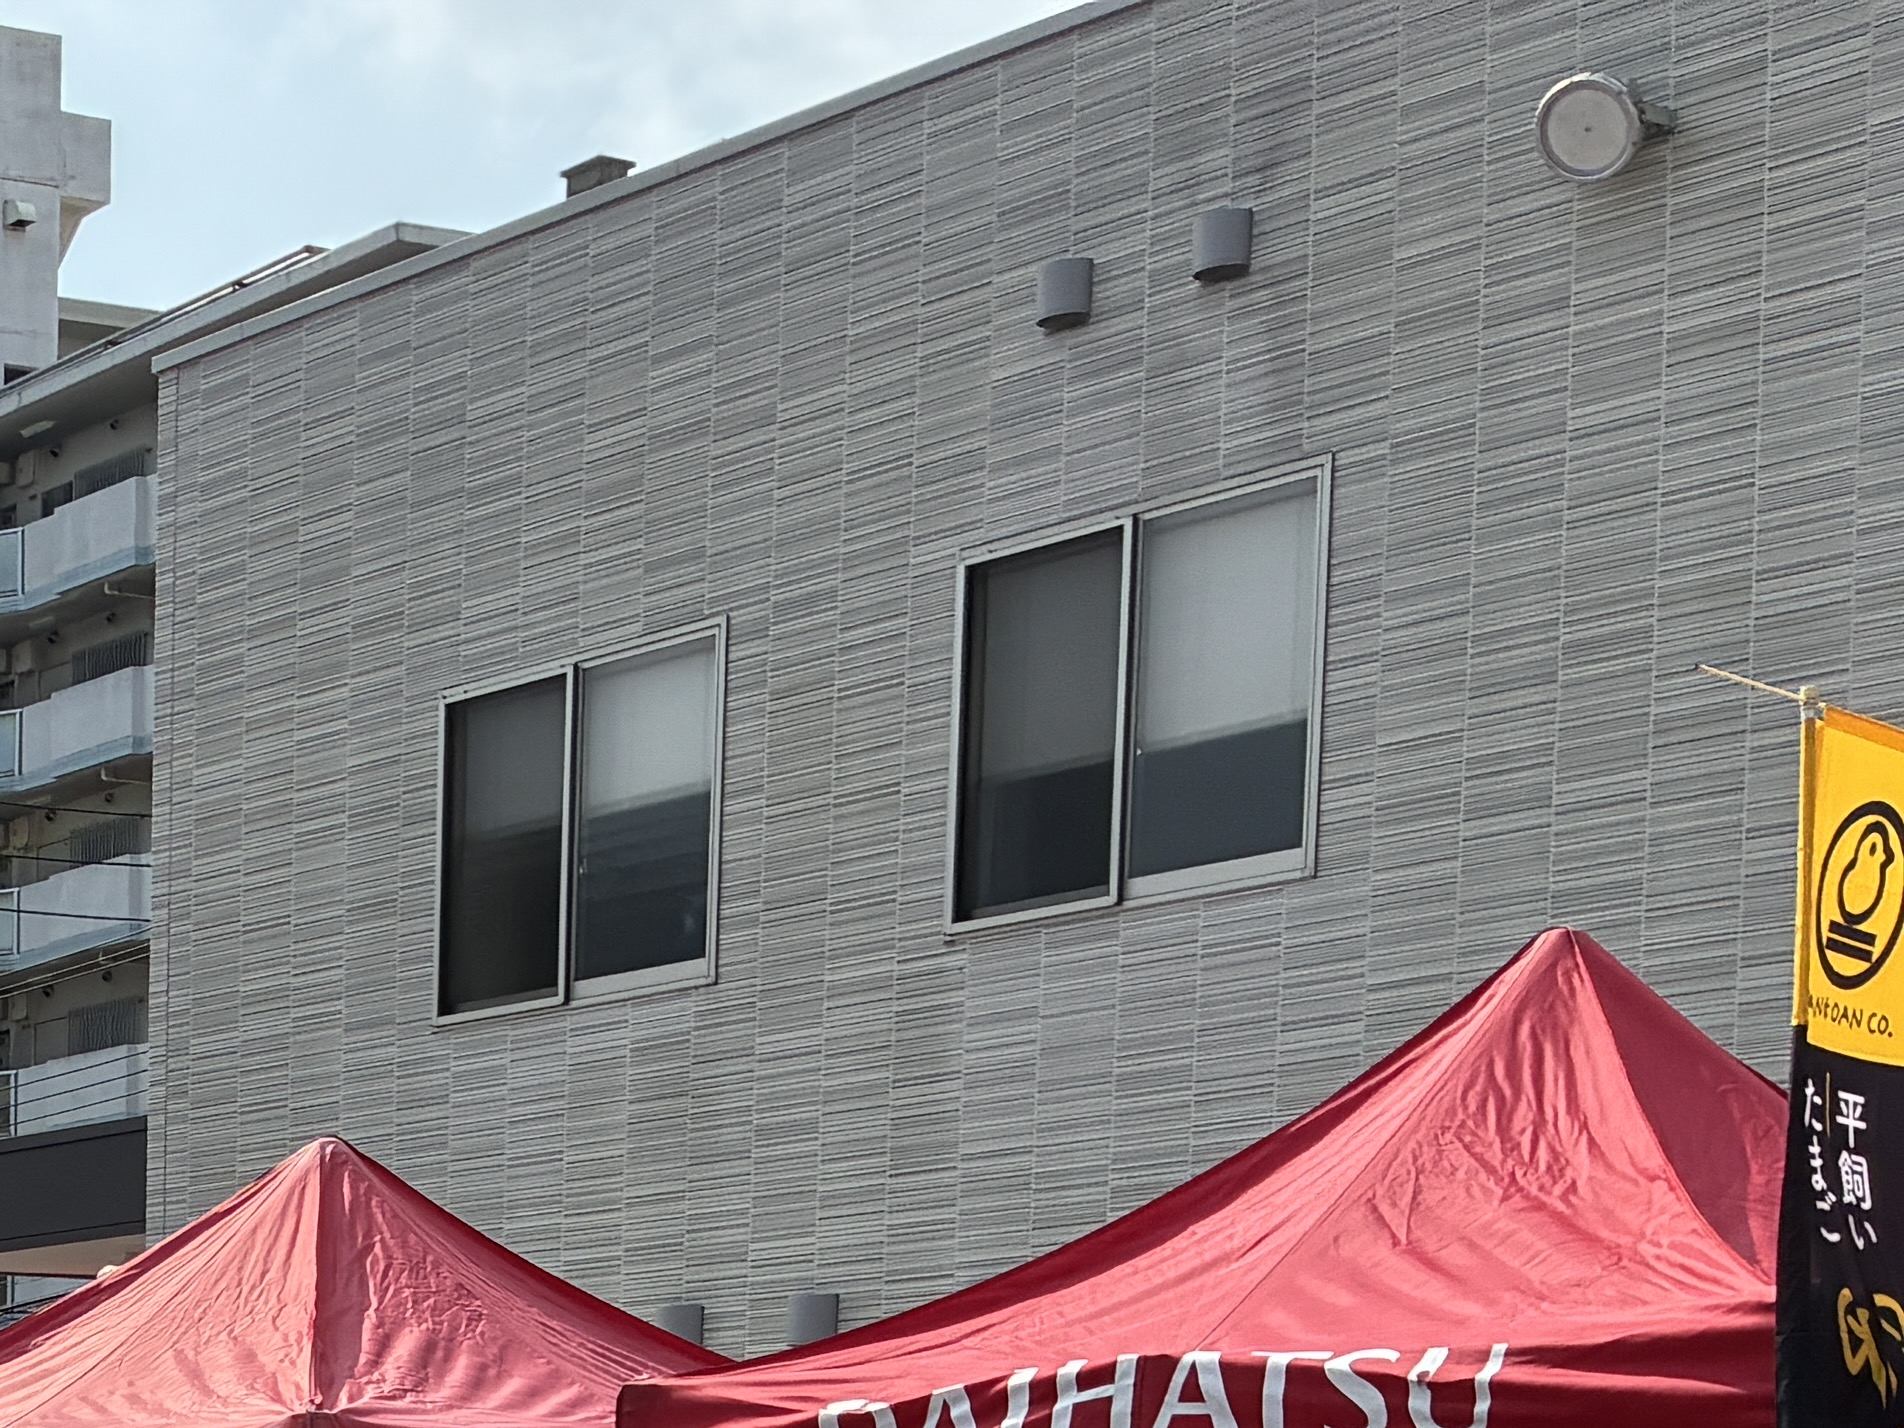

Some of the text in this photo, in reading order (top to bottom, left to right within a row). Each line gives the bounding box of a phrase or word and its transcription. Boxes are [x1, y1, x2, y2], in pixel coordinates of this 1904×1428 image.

[1867, 1012, 1893, 1038] CO.
[1804, 1078, 1841, 1242] たまご
[1836, 1090, 1878, 1250] 平飼い
